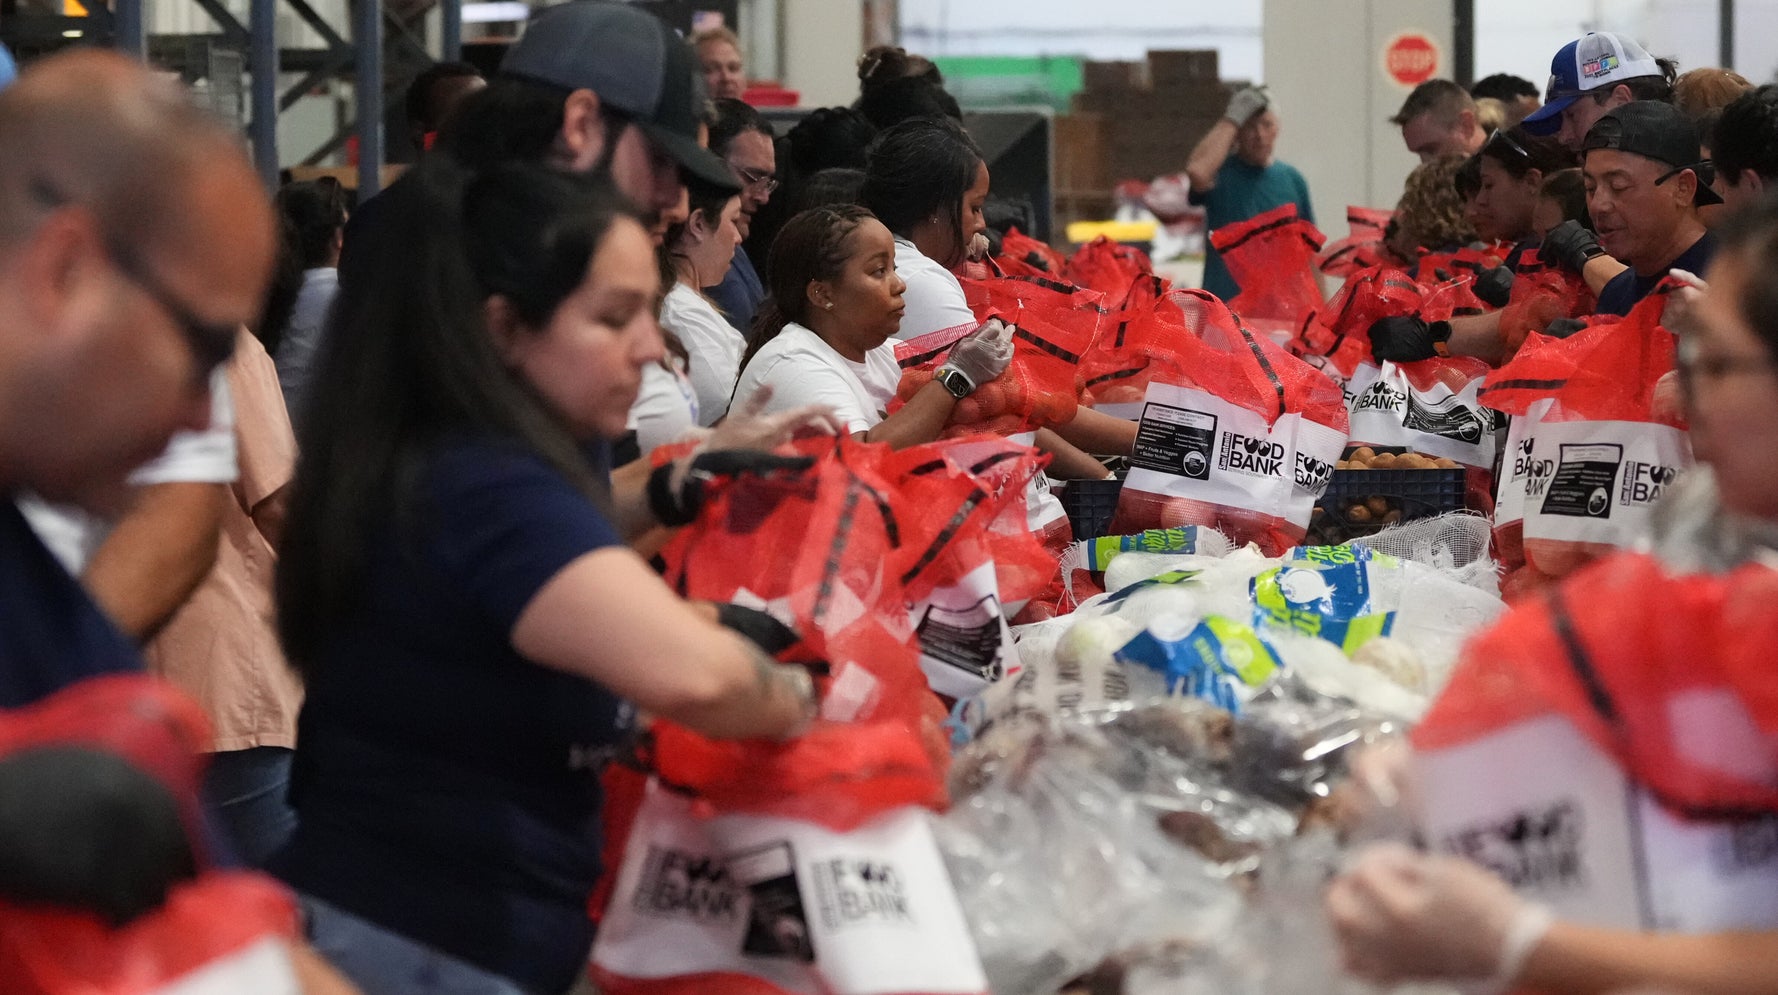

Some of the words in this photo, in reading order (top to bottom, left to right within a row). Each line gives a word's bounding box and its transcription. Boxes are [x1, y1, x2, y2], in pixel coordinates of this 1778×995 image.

[1389, 49, 1434, 69] STOP
[1360, 395, 1403, 411] BANK
[1221, 432, 1231, 456] Antonio
[1231, 434, 1285, 460] FOOD
[1229, 450, 1283, 477] BANK
[1295, 451, 1334, 481] FOOD
[1635, 462, 1677, 486] FOO
[1294, 468, 1328, 494] BANK
[1632, 482, 1661, 503] BA
